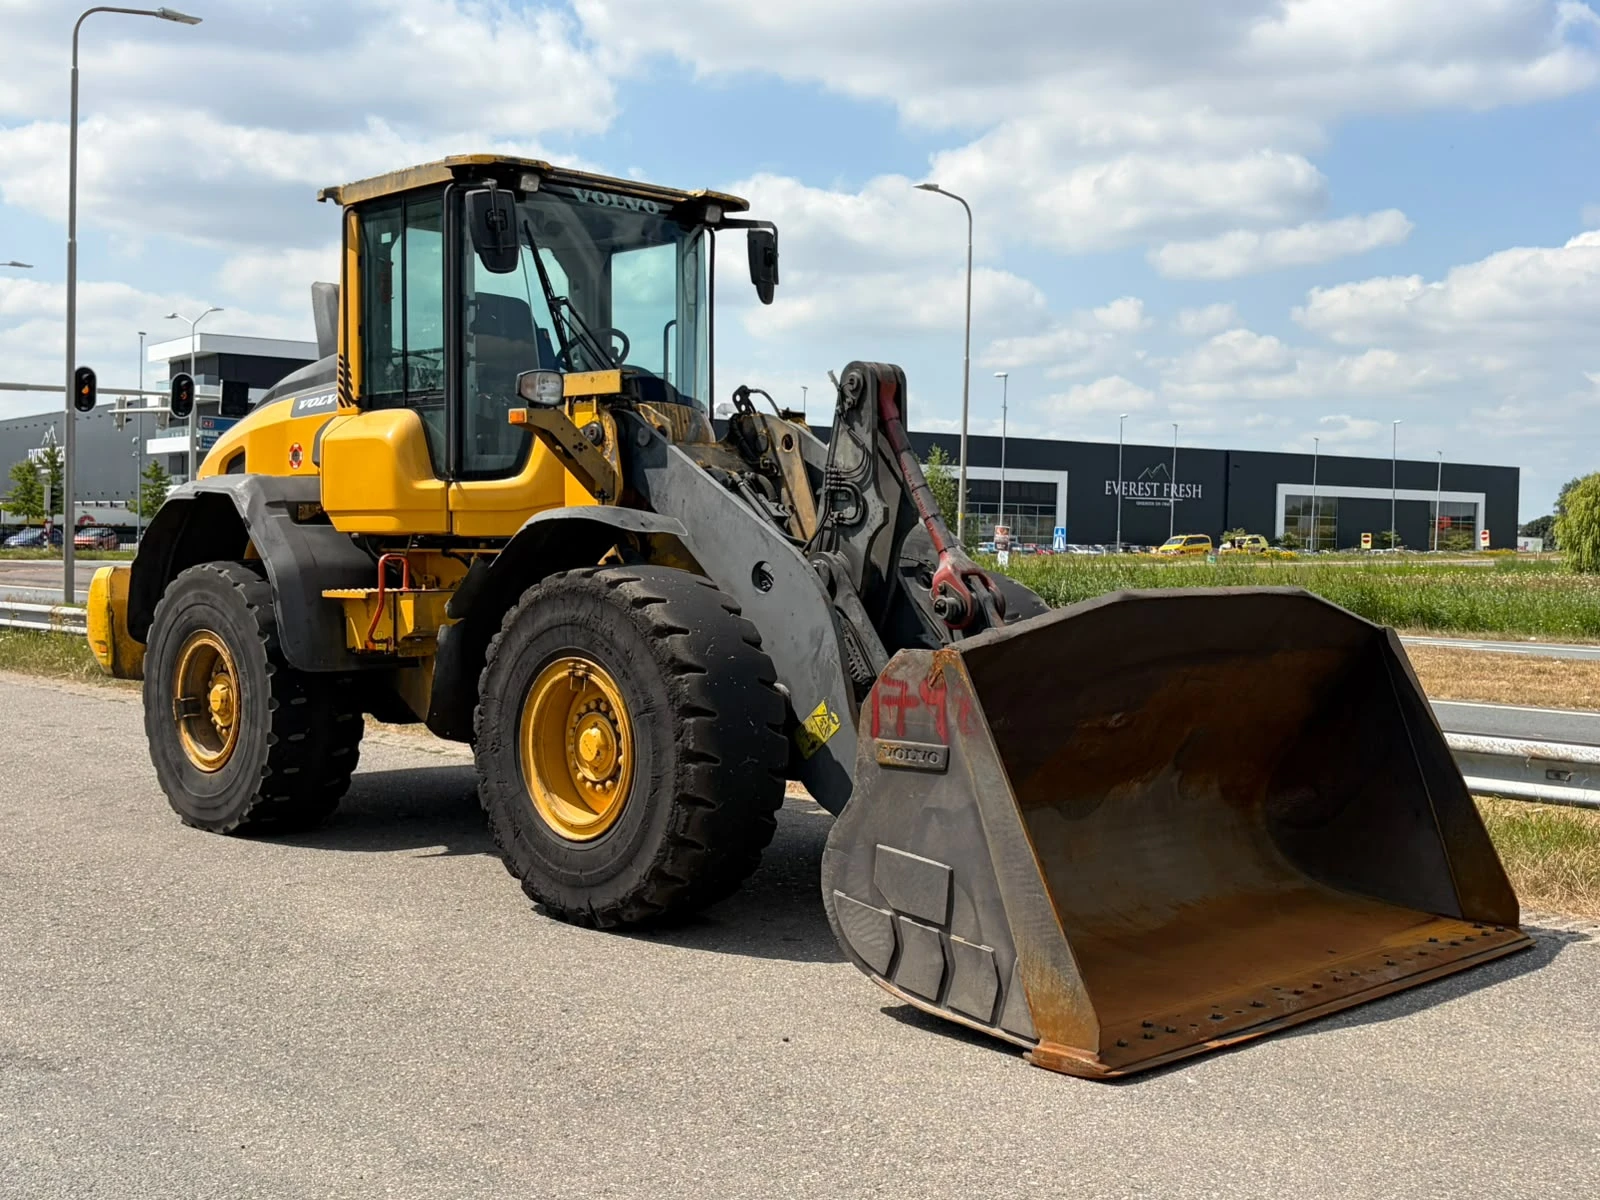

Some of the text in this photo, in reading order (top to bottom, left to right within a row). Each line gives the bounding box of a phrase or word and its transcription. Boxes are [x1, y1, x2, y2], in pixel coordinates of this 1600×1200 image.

[569, 187, 660, 215] VOLVO
[298, 393, 338, 410] VOLV
[1105, 480, 1202, 498] EVEREST FRESH
[881, 745, 941, 764] VOLVO
